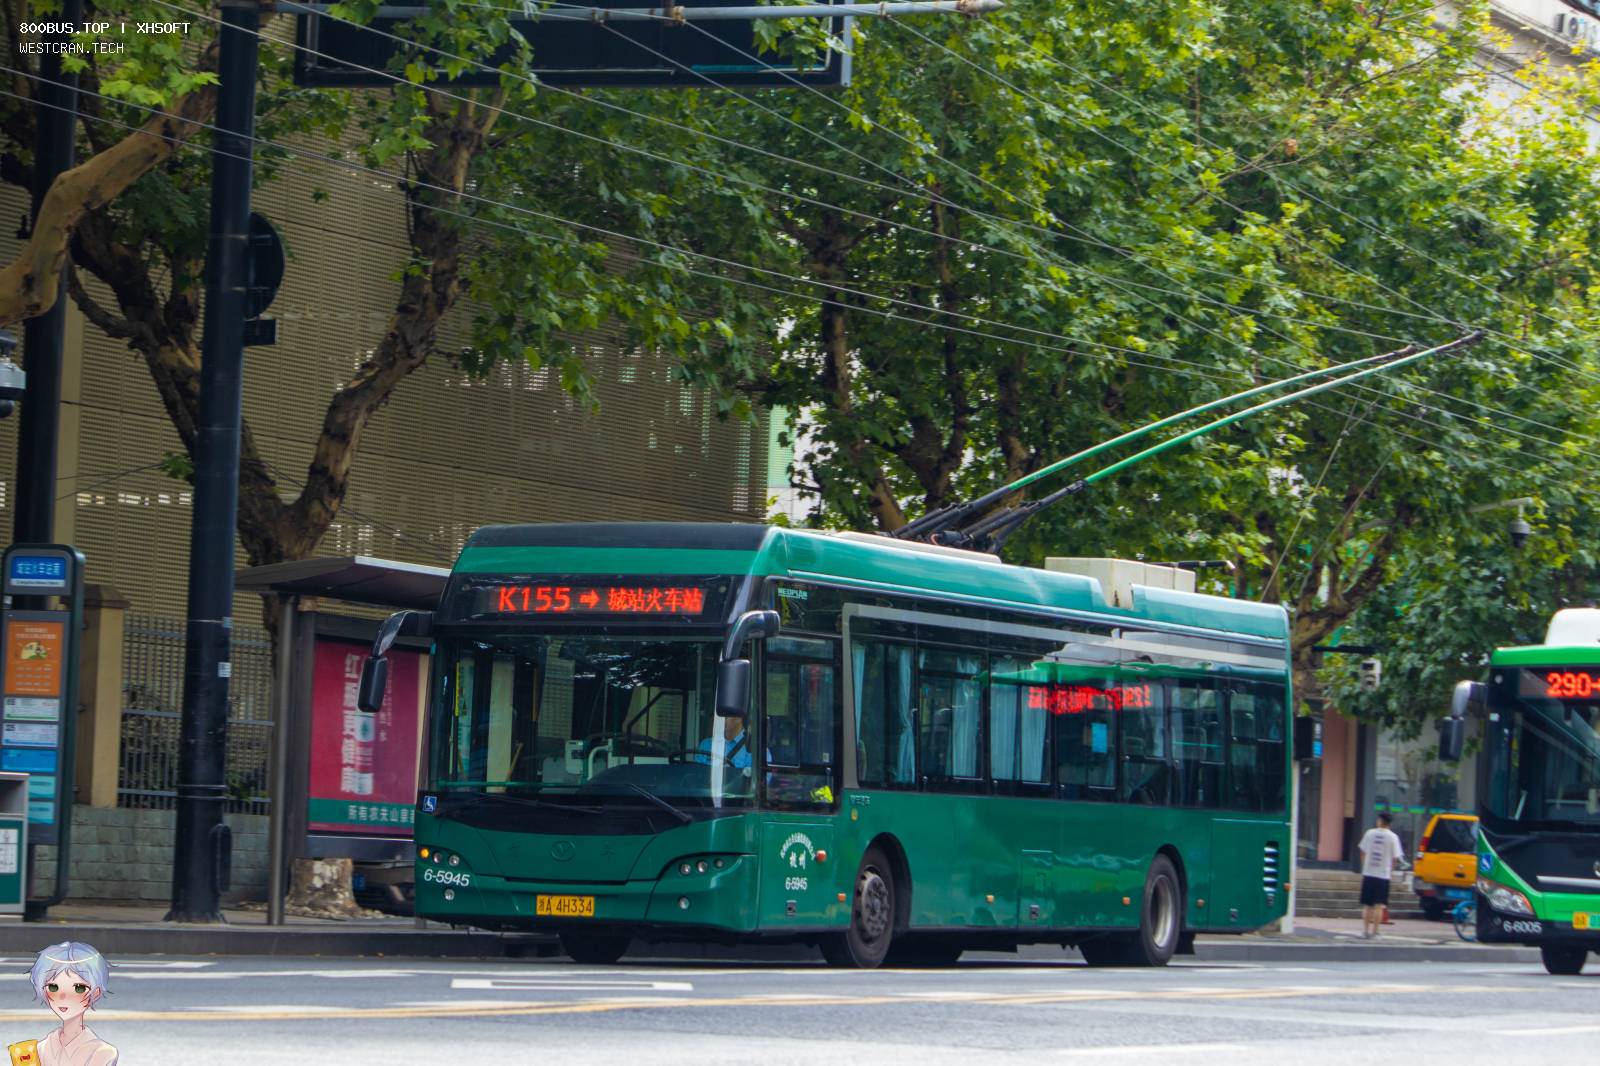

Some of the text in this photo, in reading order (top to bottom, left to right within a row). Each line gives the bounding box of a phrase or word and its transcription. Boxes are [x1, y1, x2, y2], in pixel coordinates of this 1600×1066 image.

[498, 586, 703, 613] K155 城站火车站
[1547, 671, 1592, 697] 290
[424, 868, 471, 887] 6-5945
[785, 876, 808, 891] 6-5945
[556, 898, 592, 913] 4H334
